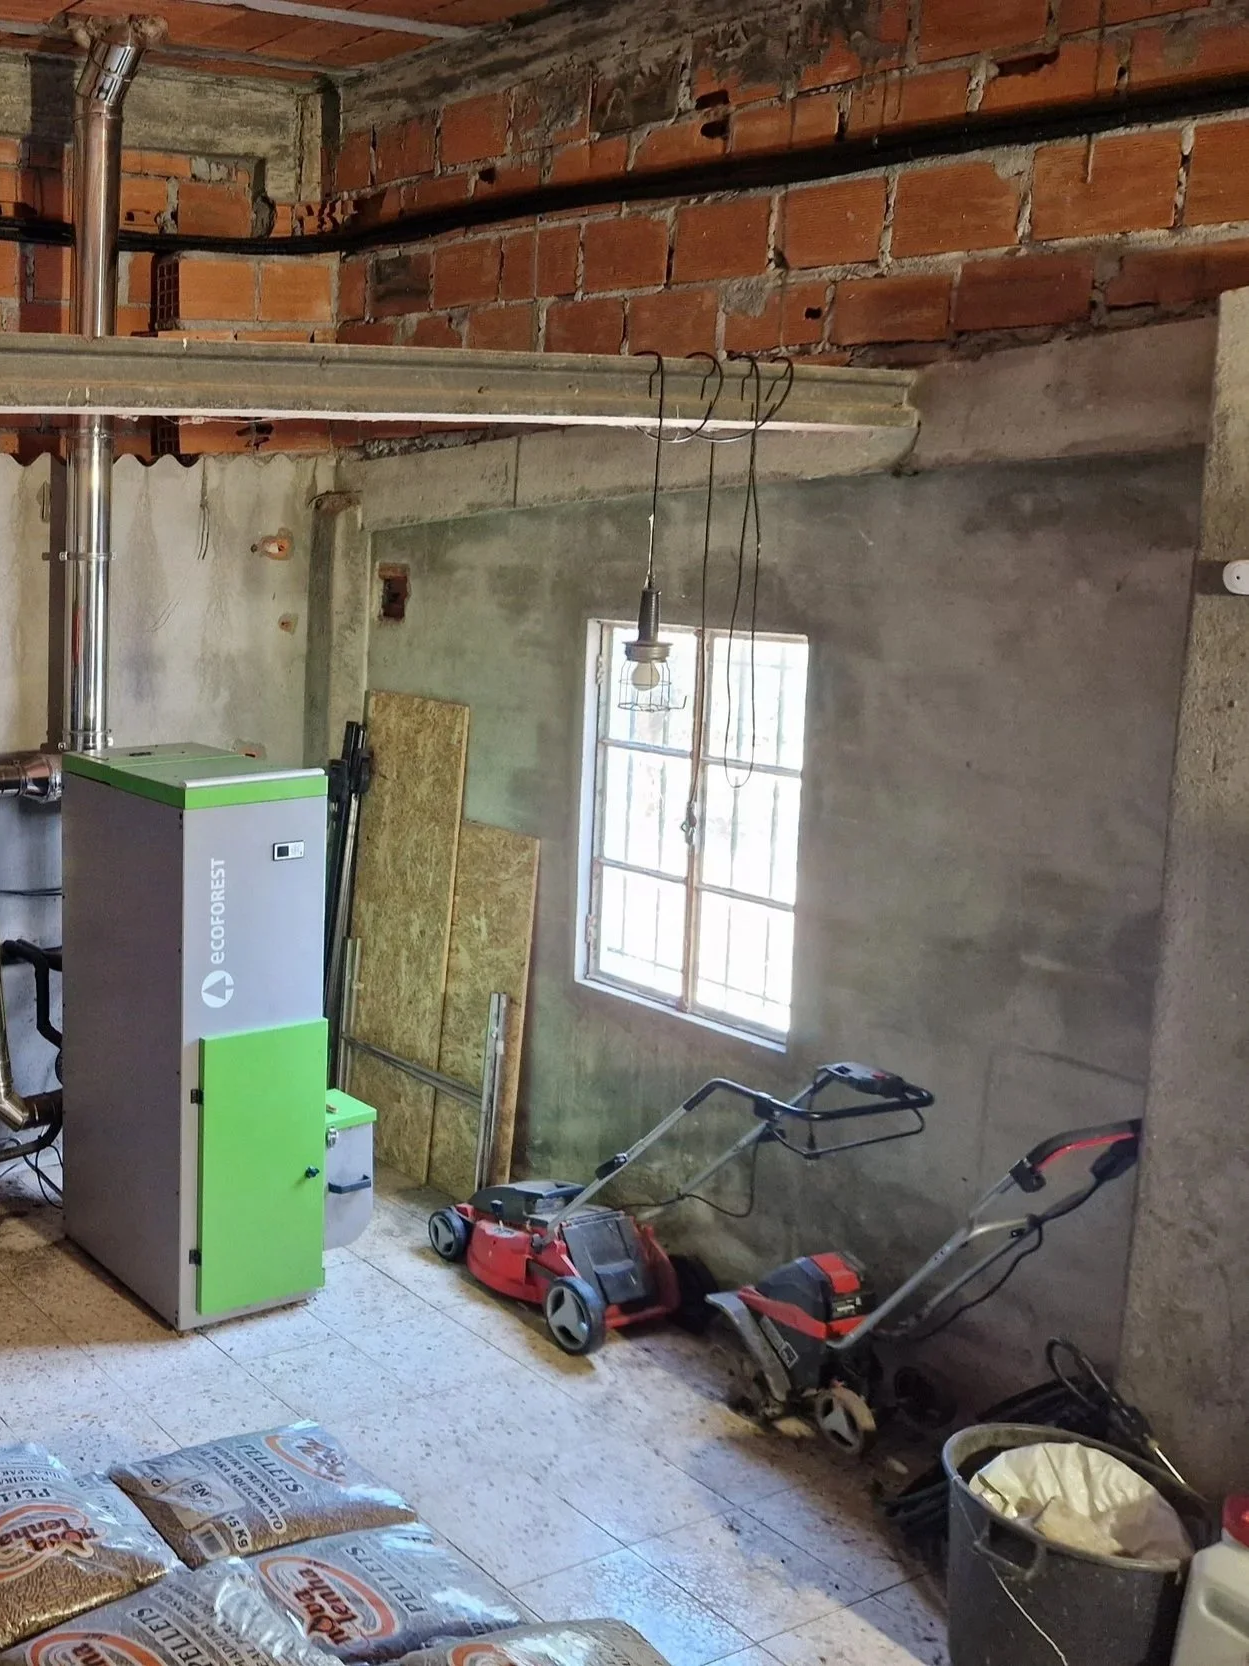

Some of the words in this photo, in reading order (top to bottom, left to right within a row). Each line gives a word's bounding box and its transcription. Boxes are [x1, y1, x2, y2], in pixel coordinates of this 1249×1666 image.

[236, 1444, 304, 1493] PELLETS
[32, 1527, 98, 1551] nova
[225, 1515, 240, 1528] 15
[235, 1529, 248, 1549] Kg
[298, 1568, 358, 1624] lenha
[346, 1547, 427, 1613] PELLETS
[131, 1608, 213, 1666] ELLETS
[294, 1588, 352, 1645] nova
